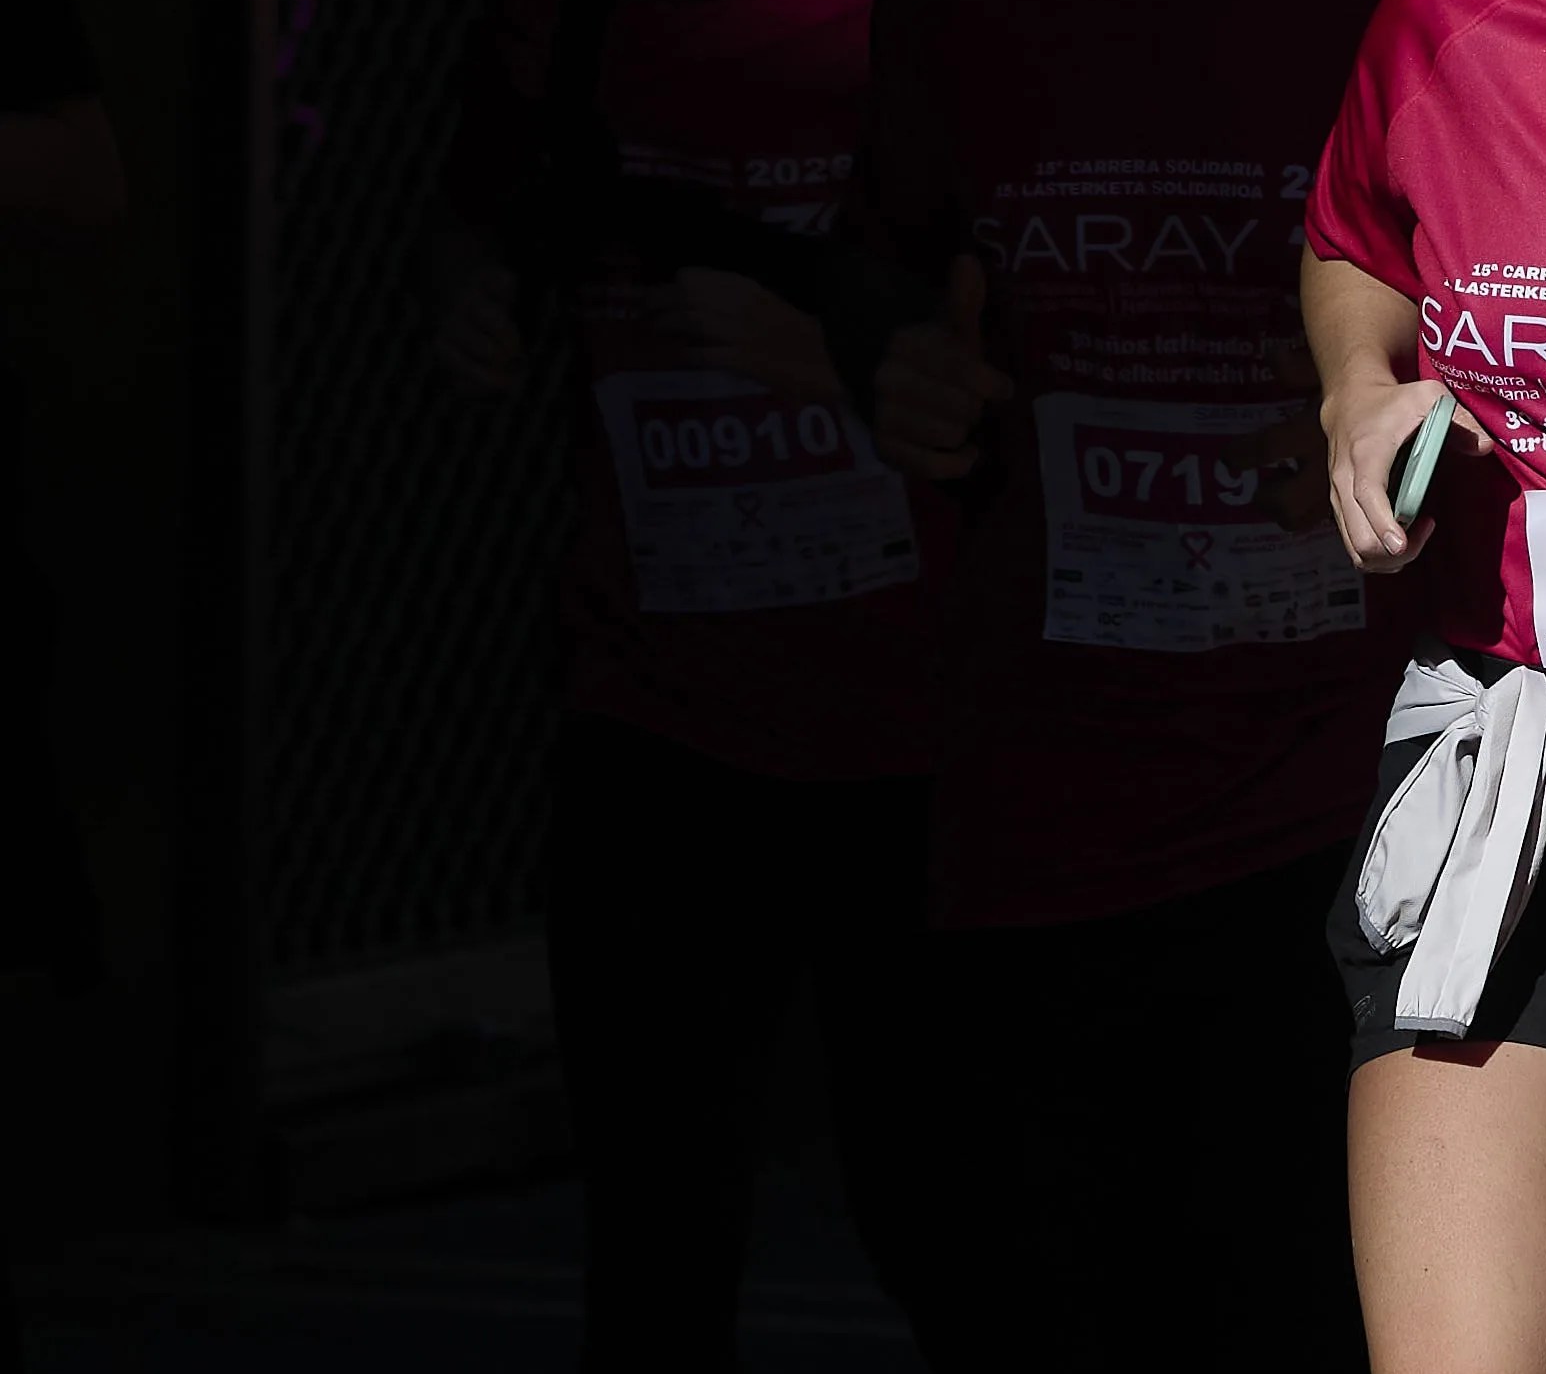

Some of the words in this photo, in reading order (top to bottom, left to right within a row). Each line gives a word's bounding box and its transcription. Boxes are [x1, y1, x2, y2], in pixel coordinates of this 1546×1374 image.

[1070, 158, 1160, 176] CARRERA
[1165, 159, 1265, 178] SOLIDARIA
[1022, 181, 1146, 198] LASTERKETA
[1150, 181, 1264, 200] SOLIDARIOA
[971, 213, 1260, 275] SARAY
[1471, 262, 1499, 279] 15ª
[1468, 370, 1526, 387] Navarra
[640, 402, 840, 472] 00910
[1083, 445, 1299, 508] 0719
